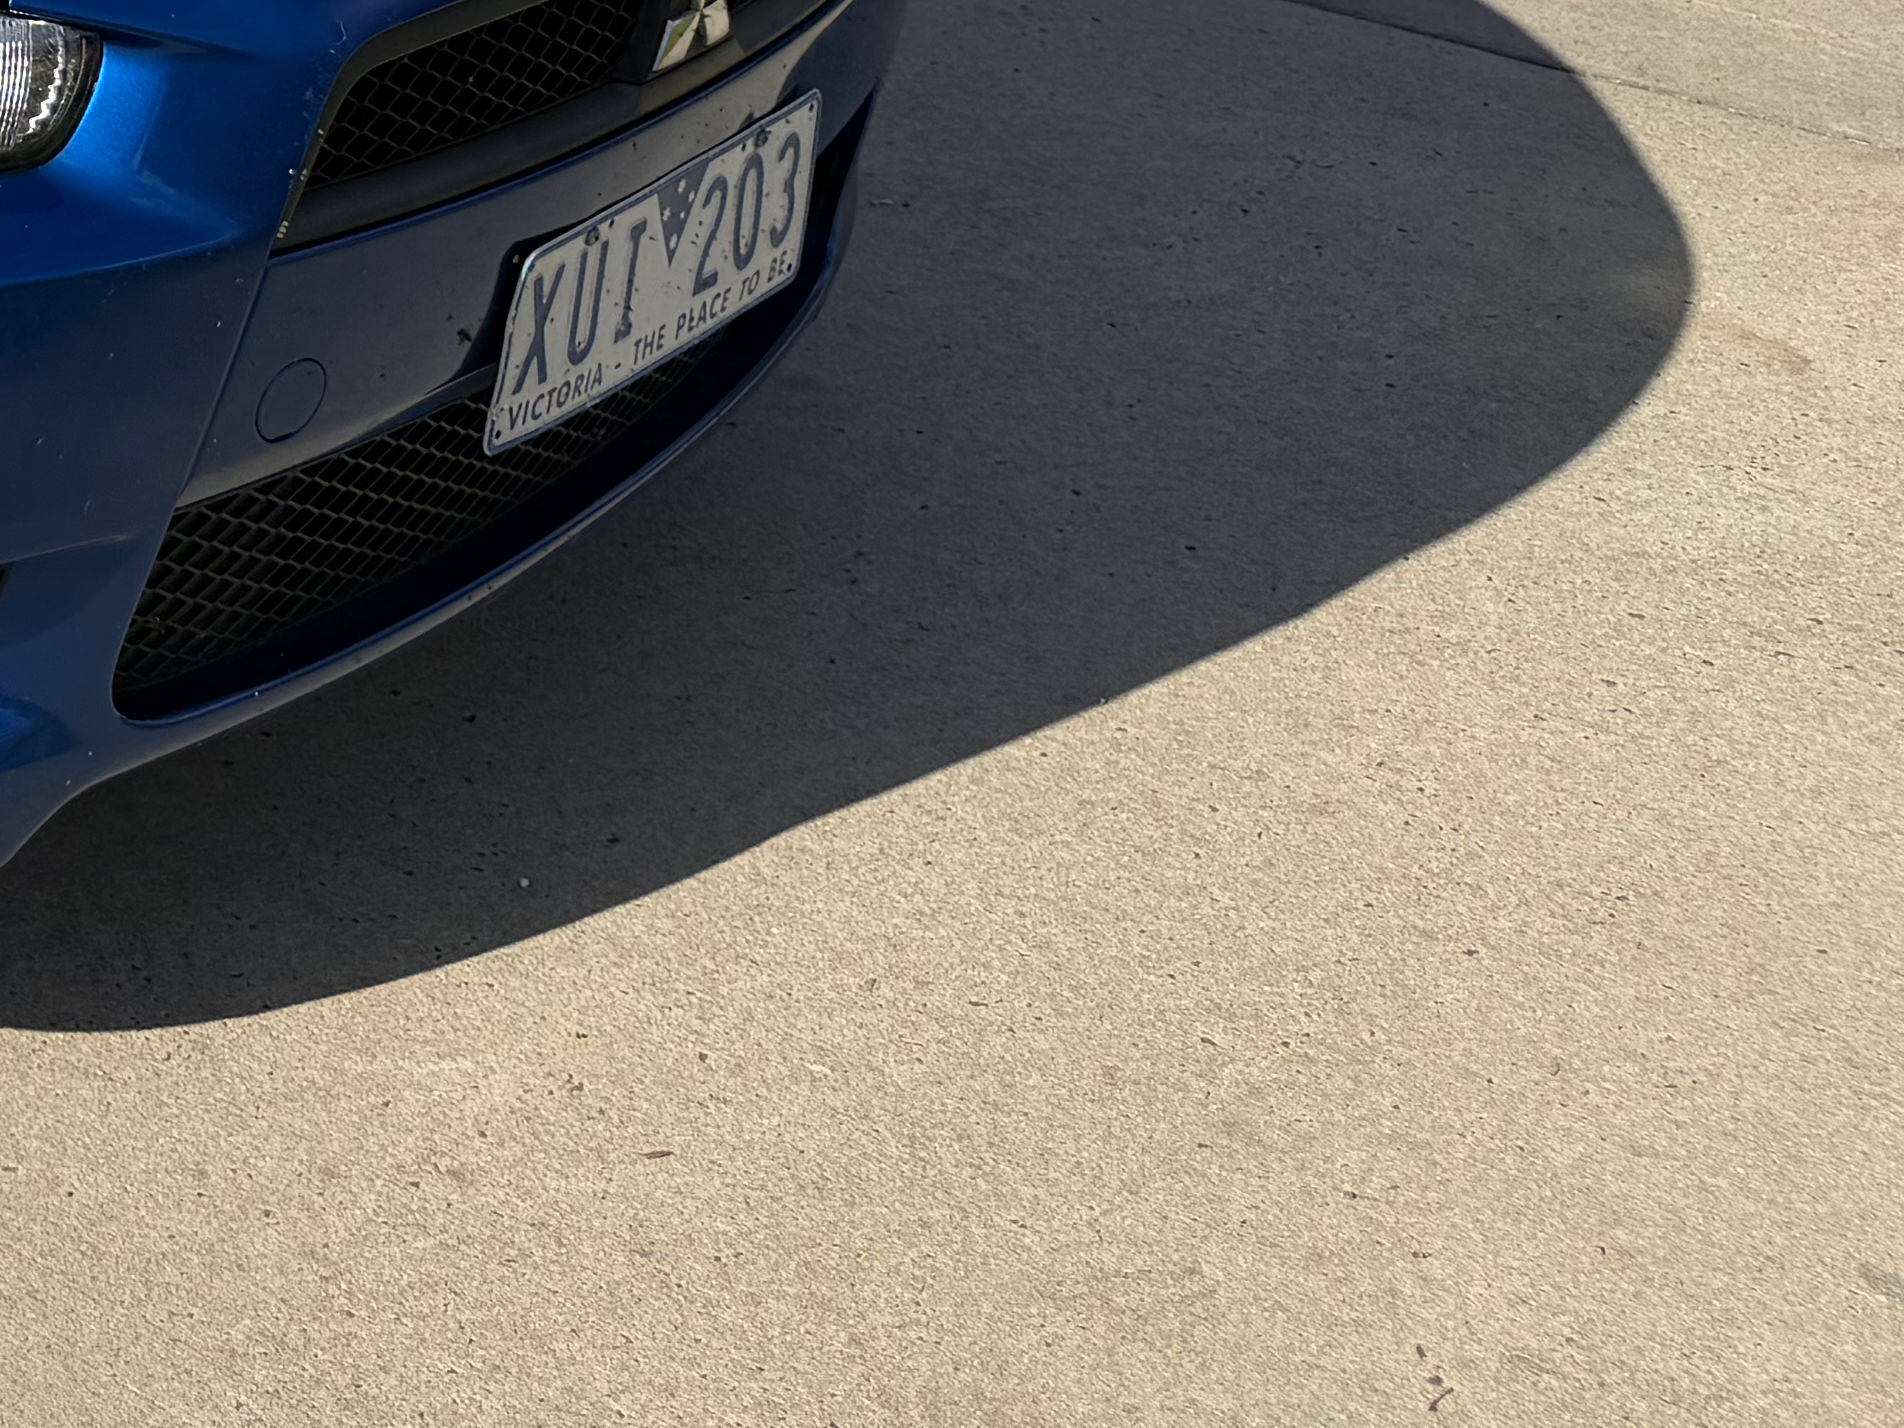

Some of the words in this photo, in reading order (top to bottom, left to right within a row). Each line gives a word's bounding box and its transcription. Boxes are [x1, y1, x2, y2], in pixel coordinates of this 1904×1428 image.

[692, 131, 802, 298] 203
[508, 361, 603, 431] VICTORIA
[633, 322, 666, 366] THE
[675, 286, 732, 341] PLACE
[738, 269, 761, 302] TO
[767, 250, 789, 283] BE
